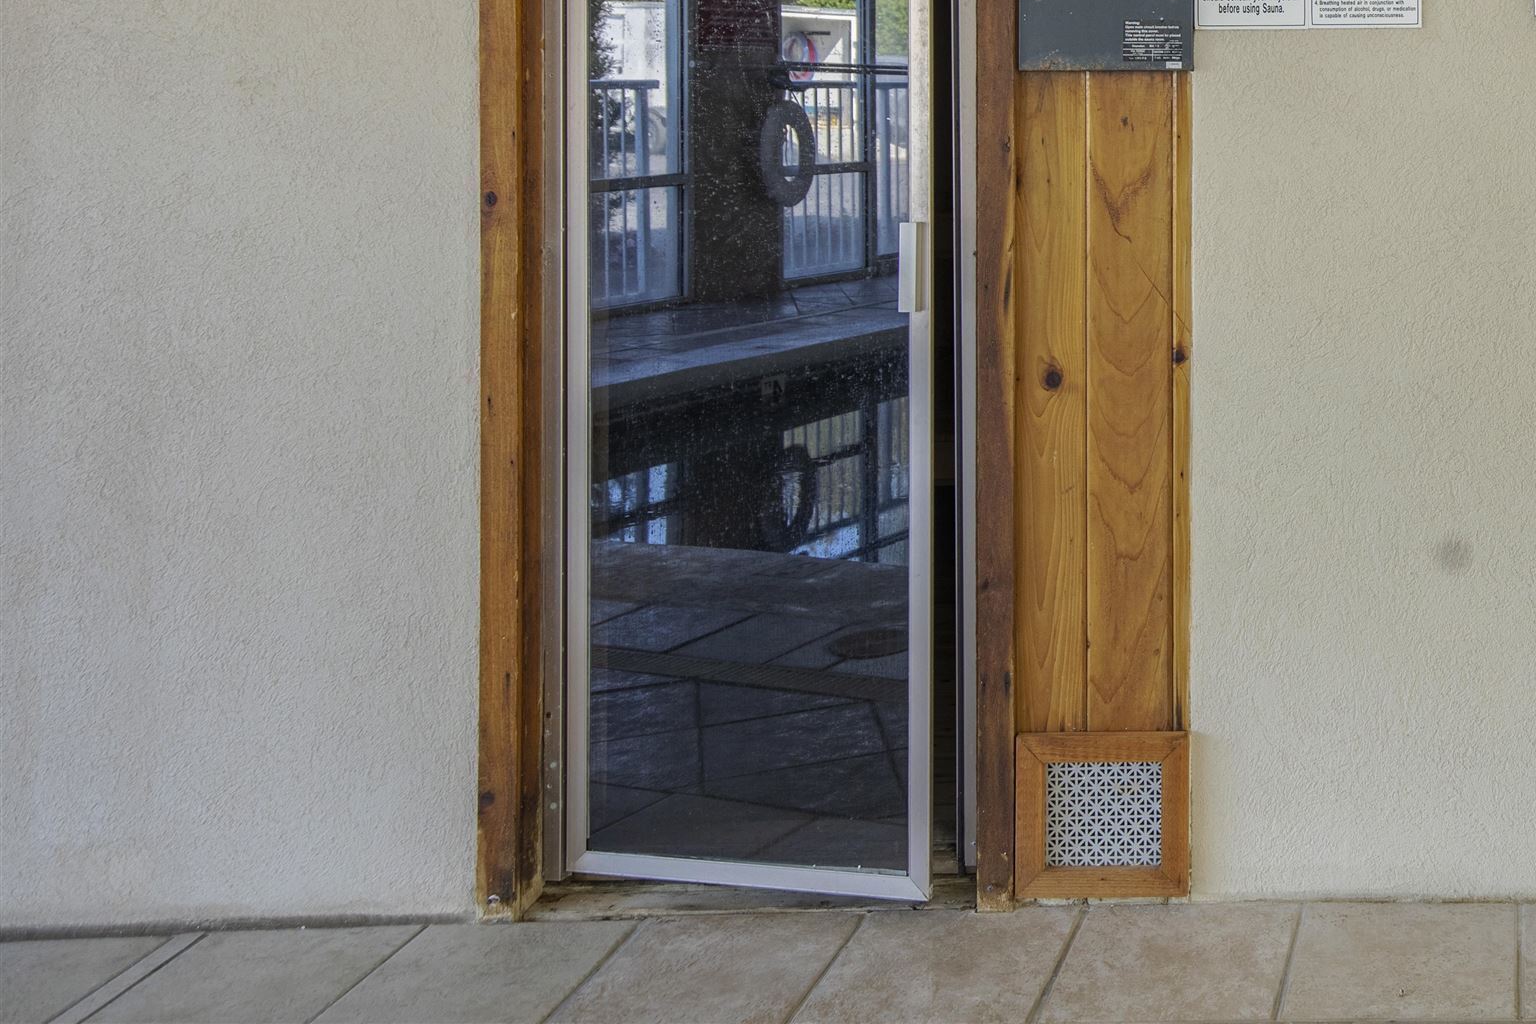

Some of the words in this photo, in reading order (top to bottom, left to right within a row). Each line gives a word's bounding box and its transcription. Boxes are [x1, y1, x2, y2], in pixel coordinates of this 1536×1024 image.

[1218, 3, 1240, 13] before
[1242, 3, 1260, 16] using
[1262, 2, 1285, 13] Sauna.
